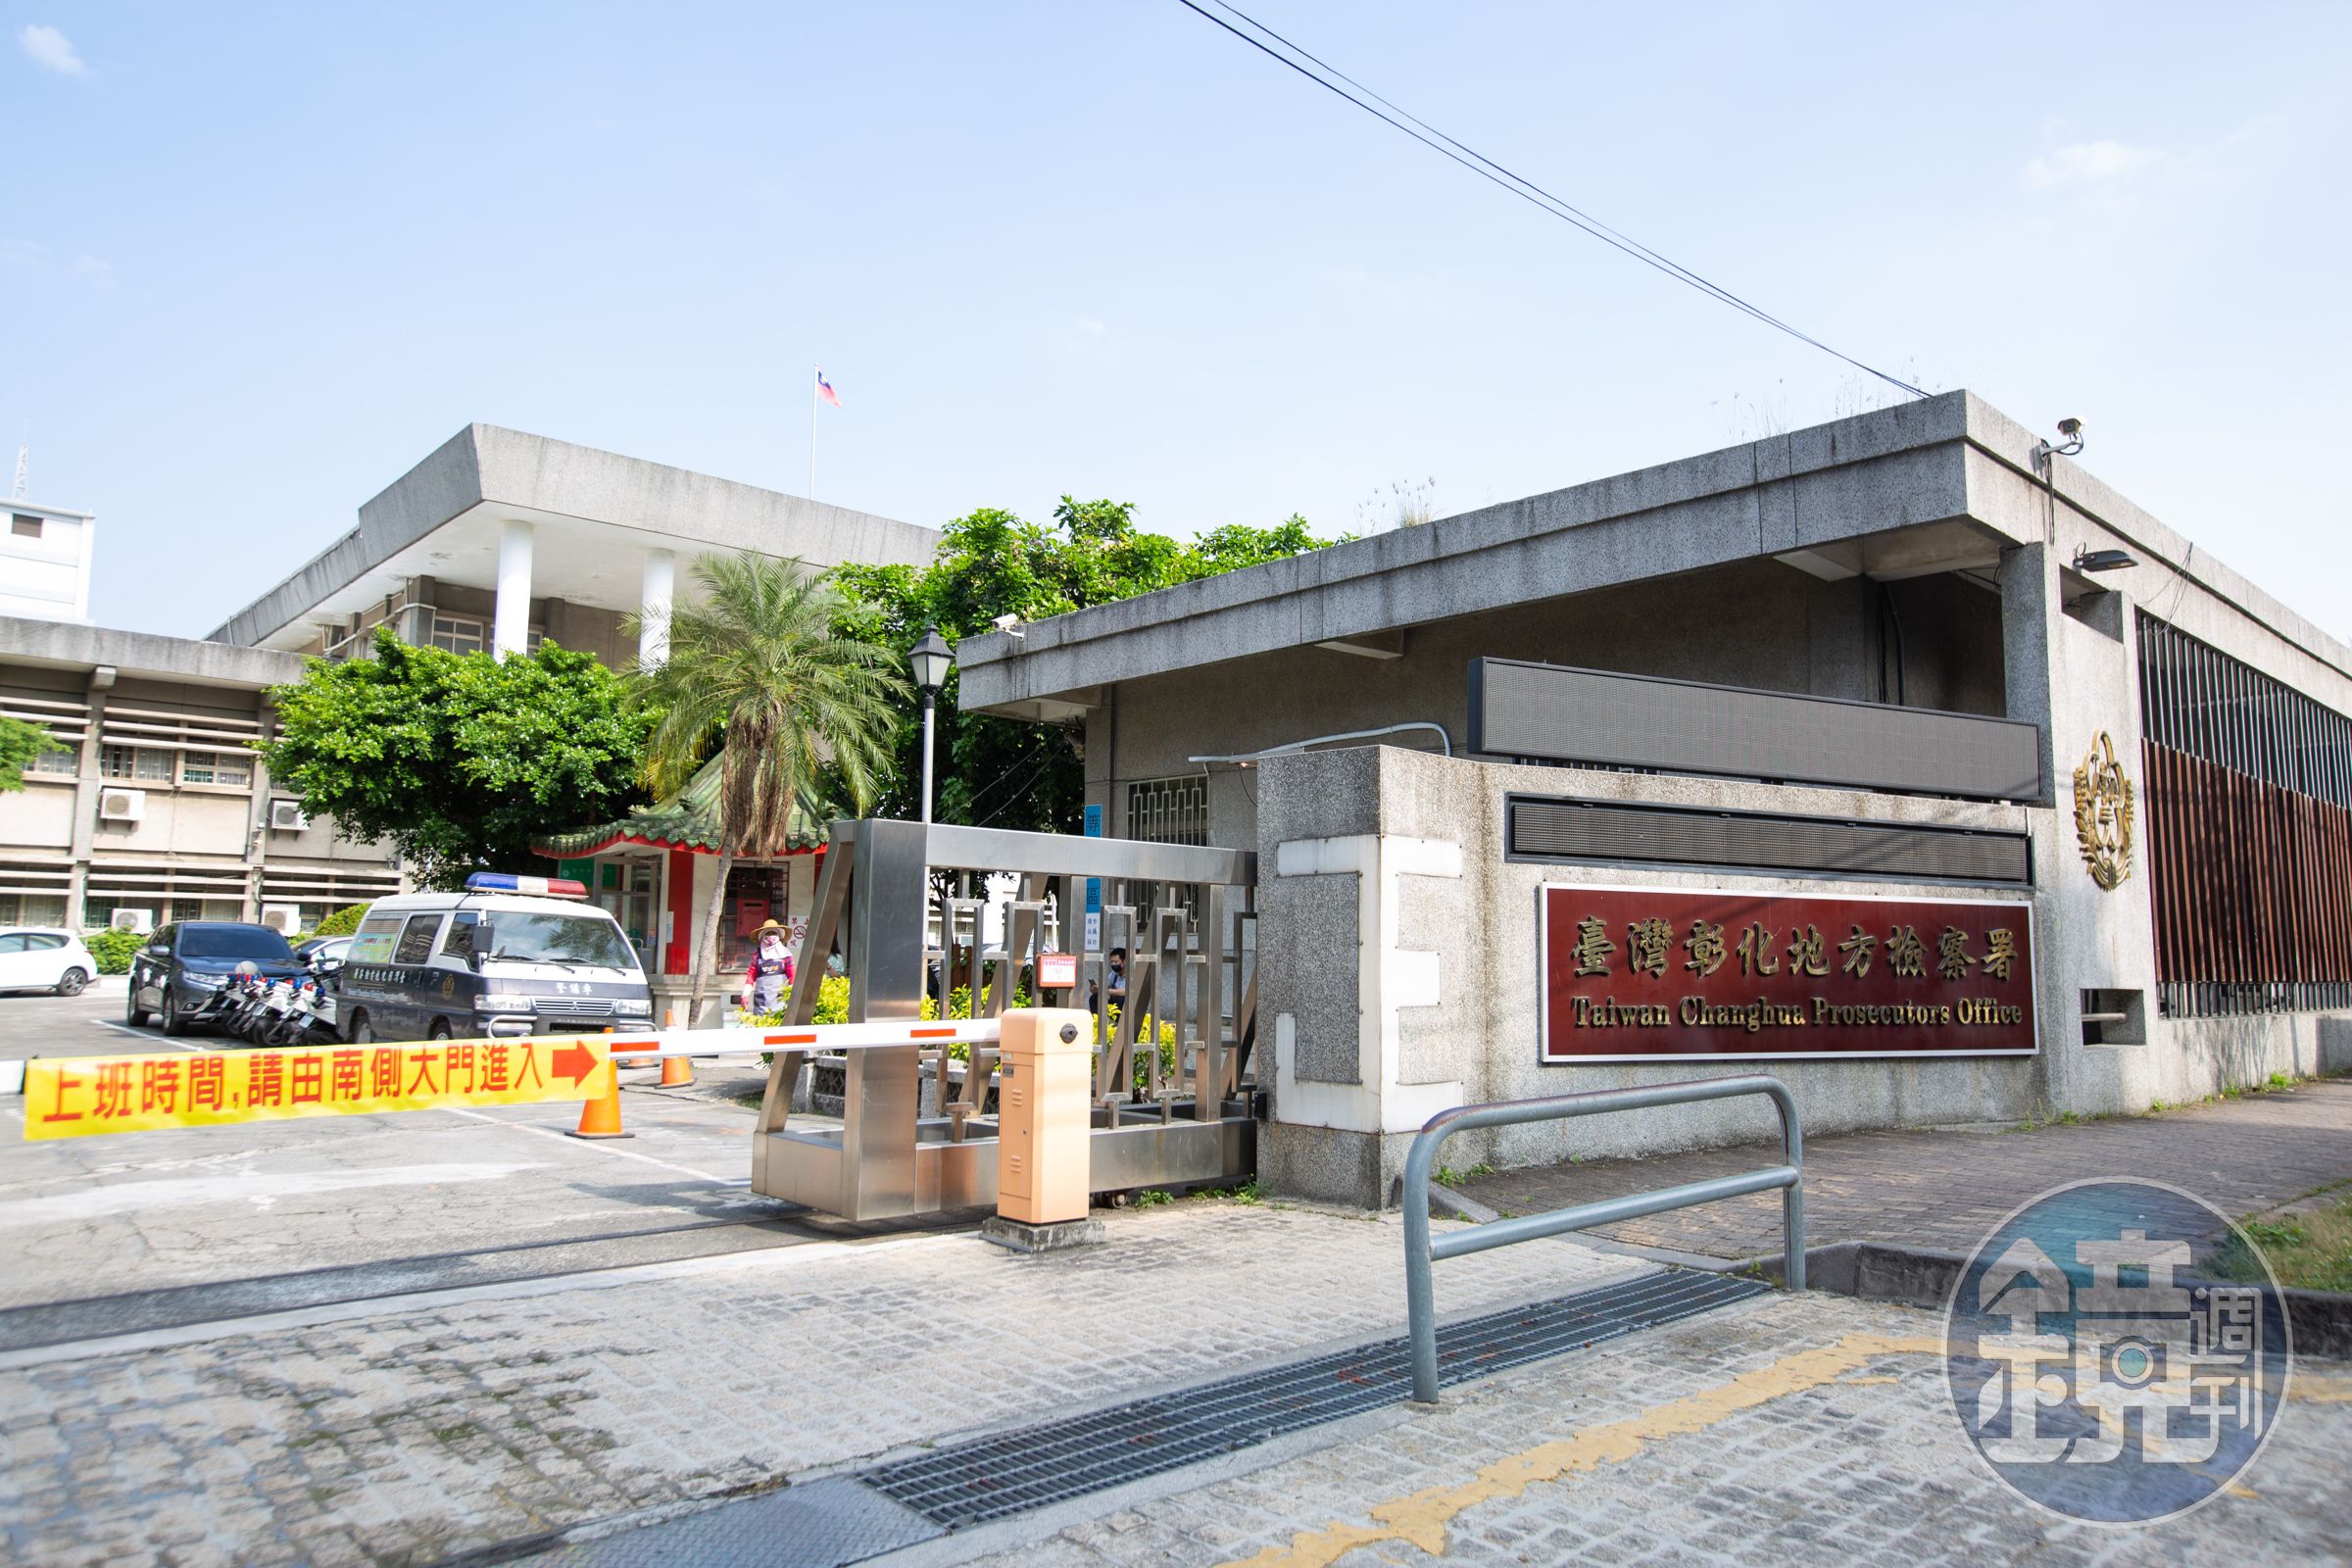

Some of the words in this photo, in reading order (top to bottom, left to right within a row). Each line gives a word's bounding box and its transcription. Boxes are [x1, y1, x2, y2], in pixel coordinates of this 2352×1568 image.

[1572, 915, 2019, 981] 臺灣彰化地方檢察署
[1571, 996, 1672, 1027] Taiwan
[1678, 996, 1806, 1032] Changhua
[1811, 997, 1950, 1026] Prosecutors
[1955, 998, 2023, 1026] Office
